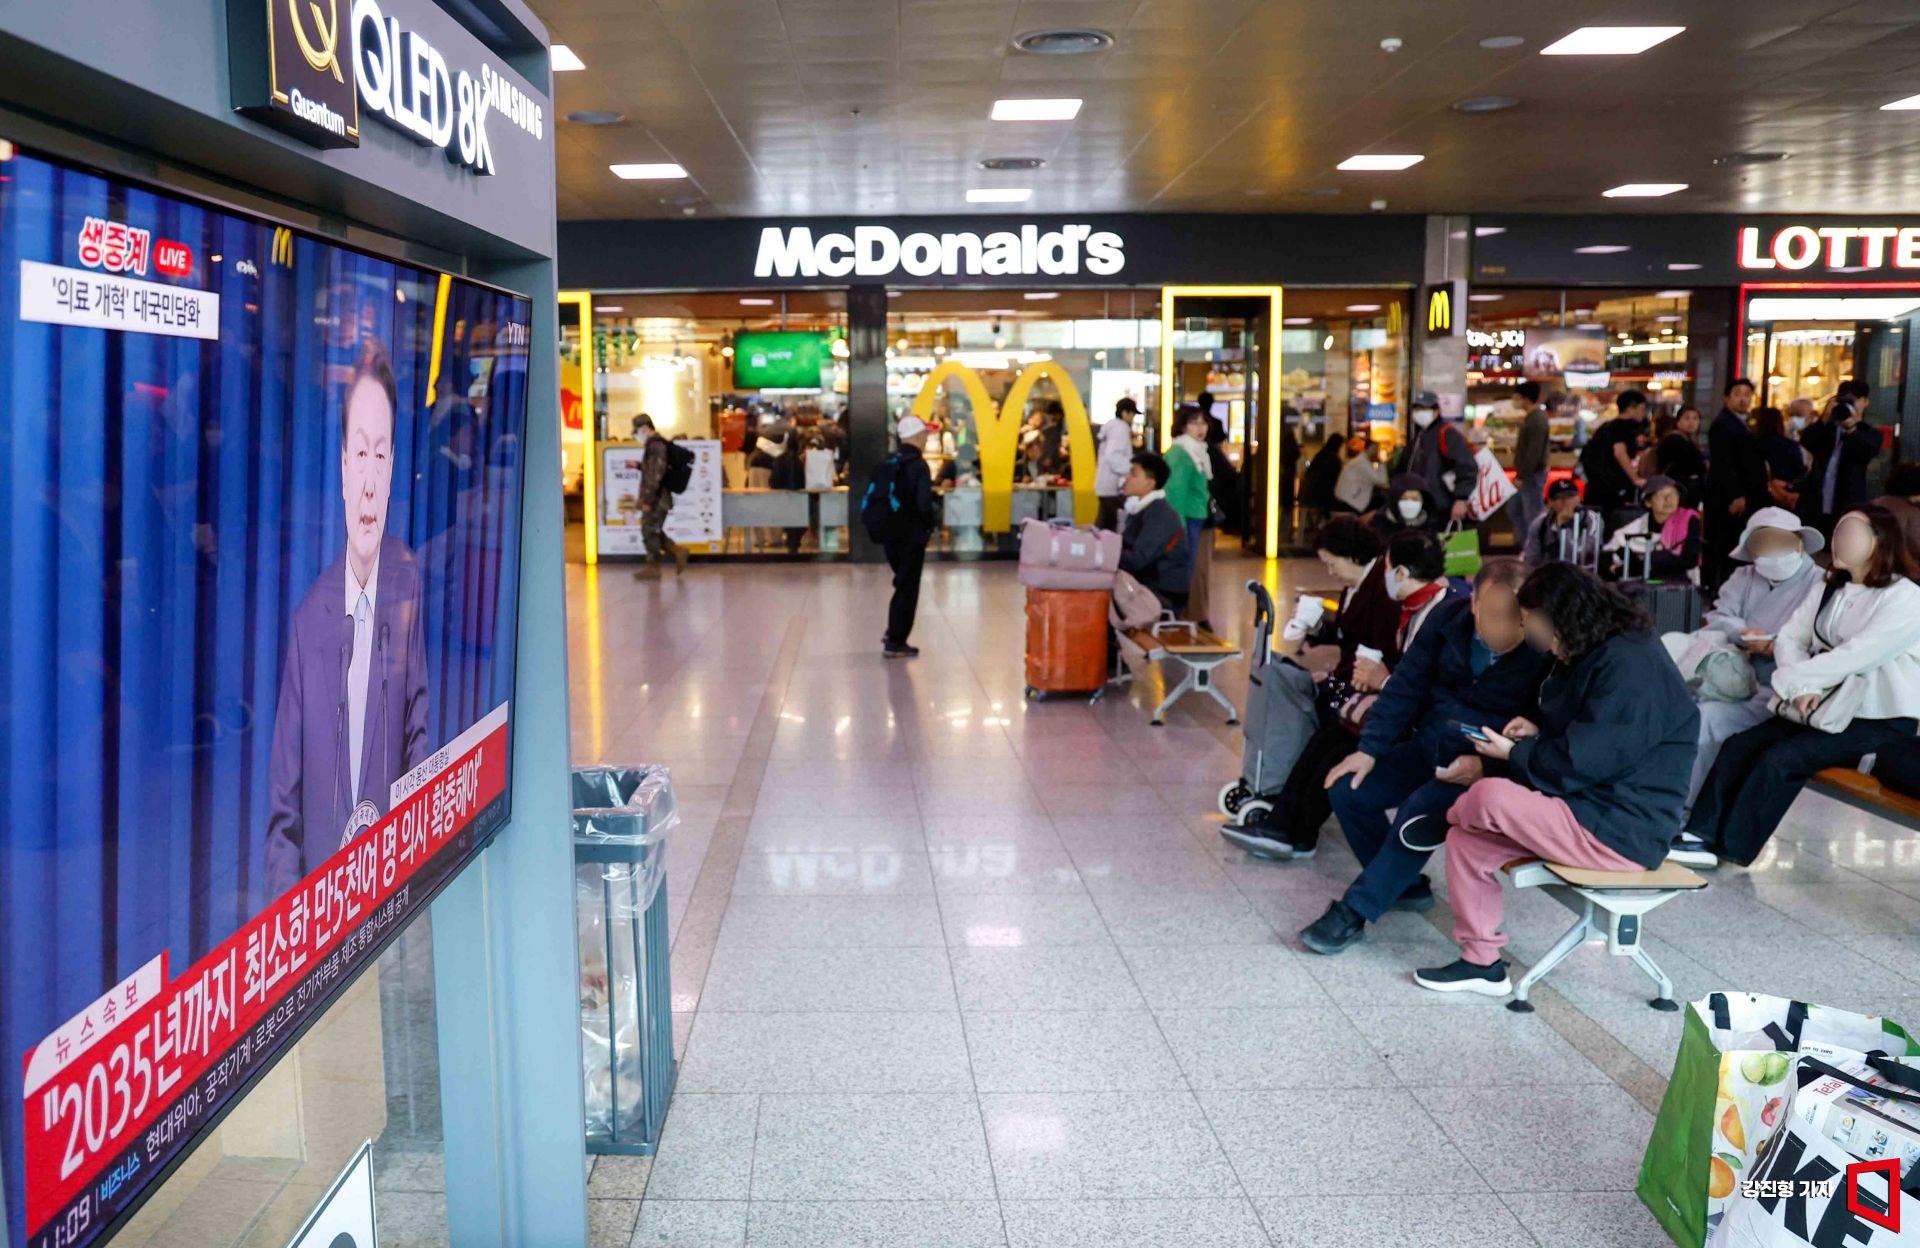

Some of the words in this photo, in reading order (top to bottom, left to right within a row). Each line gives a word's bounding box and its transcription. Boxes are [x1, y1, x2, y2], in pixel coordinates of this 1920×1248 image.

[290, 89, 345, 136] Quantum
[352, 0, 453, 147] QLED
[457, 70, 495, 176] 8K
[481, 63, 542, 140] SAMSUNG
[79, 217, 150, 275] 생중계
[160, 246, 187, 270] LIVE
[753, 224, 1126, 278] McDonald's
[52, 276, 90, 313] '의료
[95, 283, 129, 320] 개혁'
[134, 290, 201, 329] 대국민담화
[507, 321, 525, 346] YTN
[243, 890, 310, 1004] 최소한
[314, 833, 378, 950] 만5천여
[382, 821, 397, 888] 명
[400, 793, 428, 866] 의사
[101, 1152, 140, 1202] 비즈니스
[146, 1087, 203, 1163] 현대위아,
[205, 996, 295, 1102] 공작기계·로봇으로
[296, 954, 340, 1012] 전기차부품
[340, 936, 357, 965] 제조
[358, 899, 395, 951] 통합시스템
[395, 883, 409, 915] 공개
